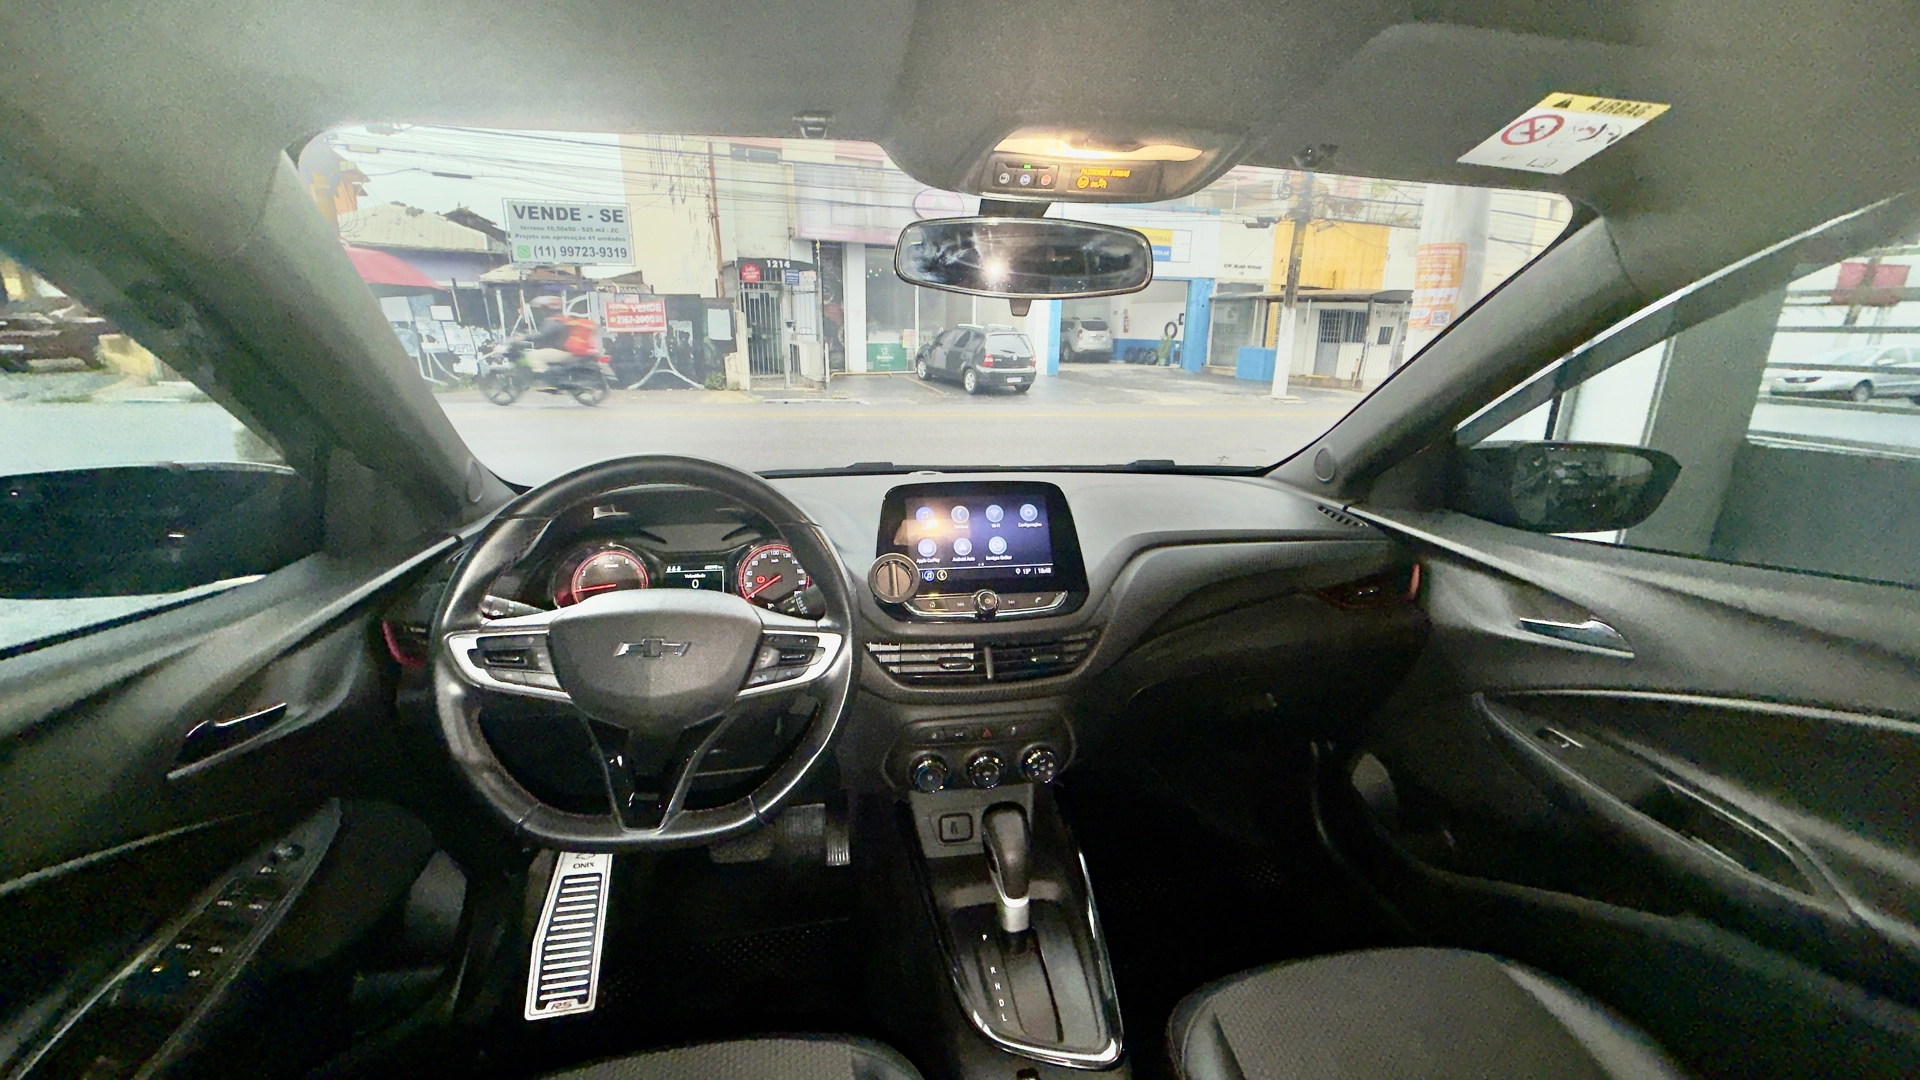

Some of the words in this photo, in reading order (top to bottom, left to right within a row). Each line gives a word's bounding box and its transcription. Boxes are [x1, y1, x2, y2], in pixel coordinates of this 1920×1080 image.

[1586, 100, 1650, 117] AIRBAG
[512, 205, 581, 222] VENDE
[600, 208, 624, 223] SE
[515, 233, 539, 241] Projeto
[552, 234, 586, 242] aprovação
[534, 245, 557, 259] (11)
[560, 246, 627, 258] 99723-9319
[766, 260, 791, 268] 1214
[630, 303, 662, 313] VENDE
[691, 579, 700, 589] 0
[572, 861, 595, 869] ONIX
[990, 966, 997, 974] R
[994, 982, 1001, 990] N
[550, 1000, 573, 1011] RS
[998, 998, 1005, 1007] D
[1001, 1013, 1008, 1022] L
